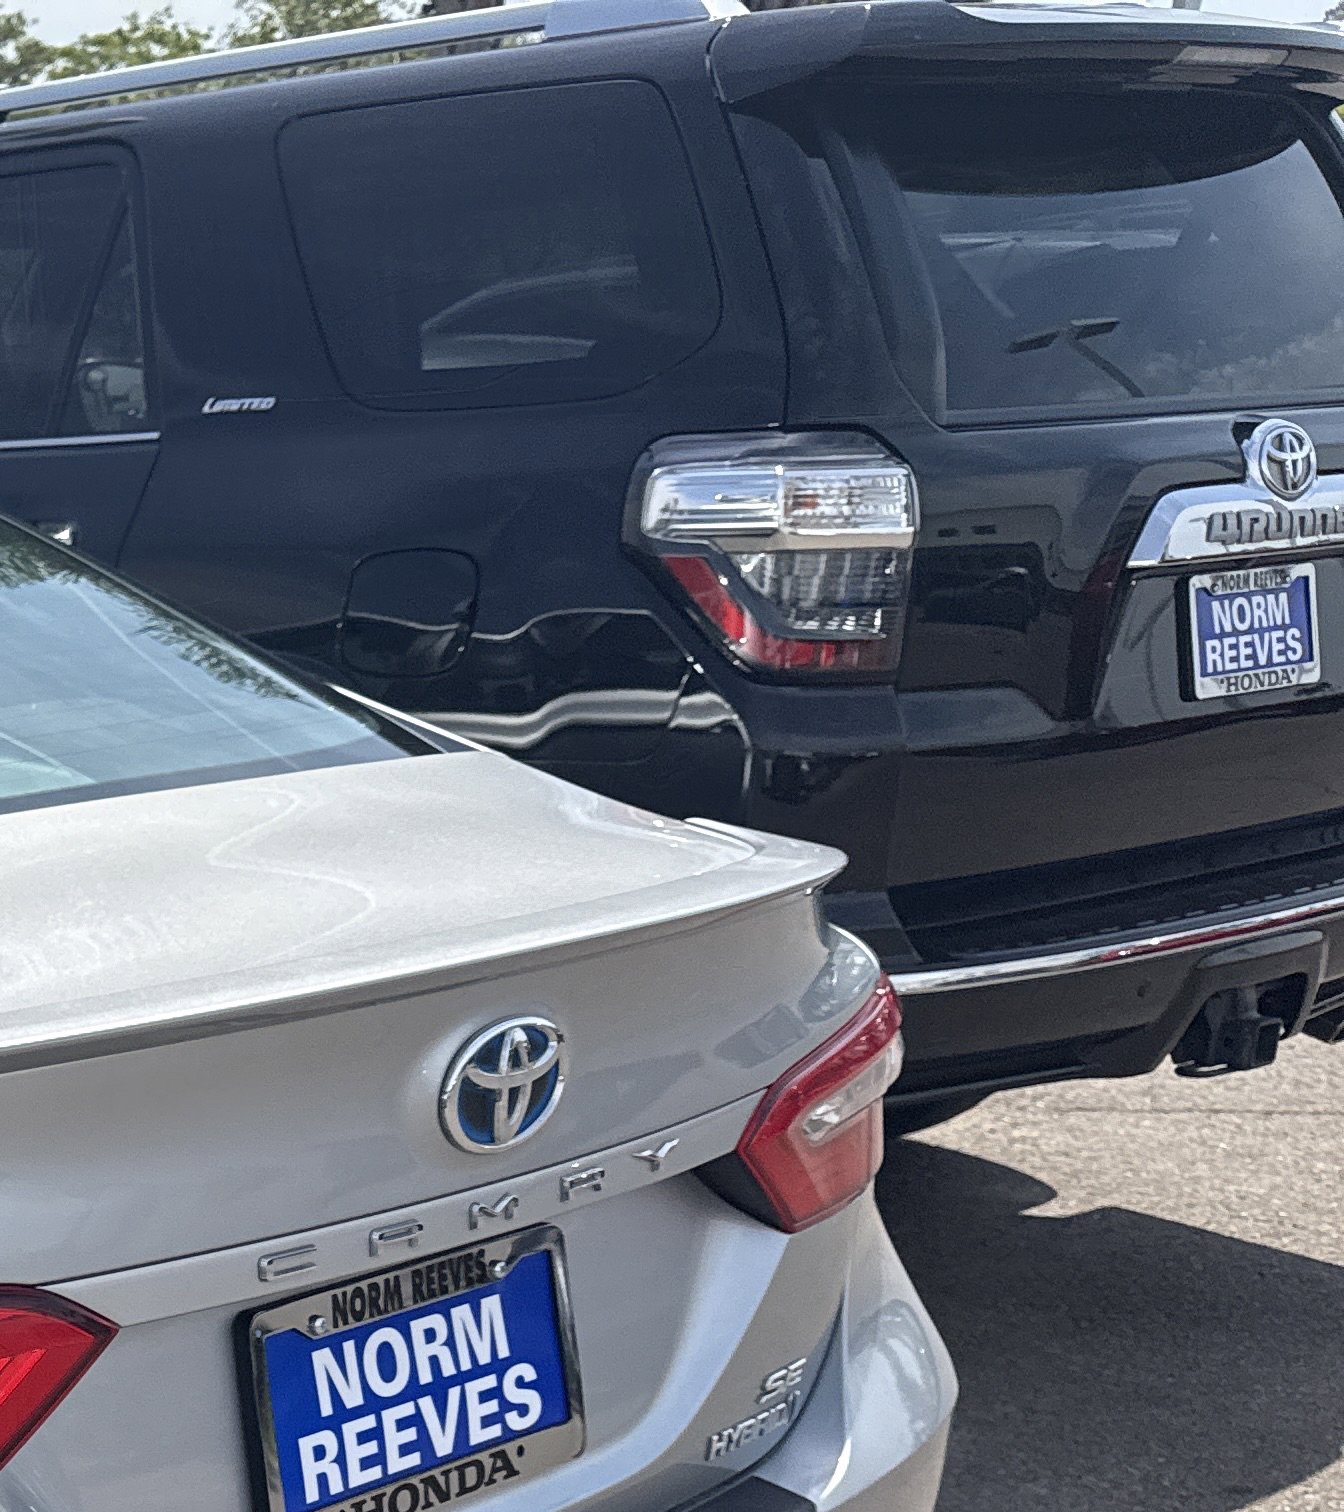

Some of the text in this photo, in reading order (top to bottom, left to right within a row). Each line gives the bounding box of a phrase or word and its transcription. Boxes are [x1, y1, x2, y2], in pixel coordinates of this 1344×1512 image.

[1211, 592, 1291, 634] NORM
[1205, 627, 1303, 673] REEVES
[1224, 668, 1293, 693] HONDA
[256, 1137, 680, 1283] CAMRY
[330, 1248, 489, 1329] NORM REEVES
[311, 1293, 511, 1418] NORM
[756, 1357, 807, 1404] SE
[297, 1362, 544, 1505] REEVES
